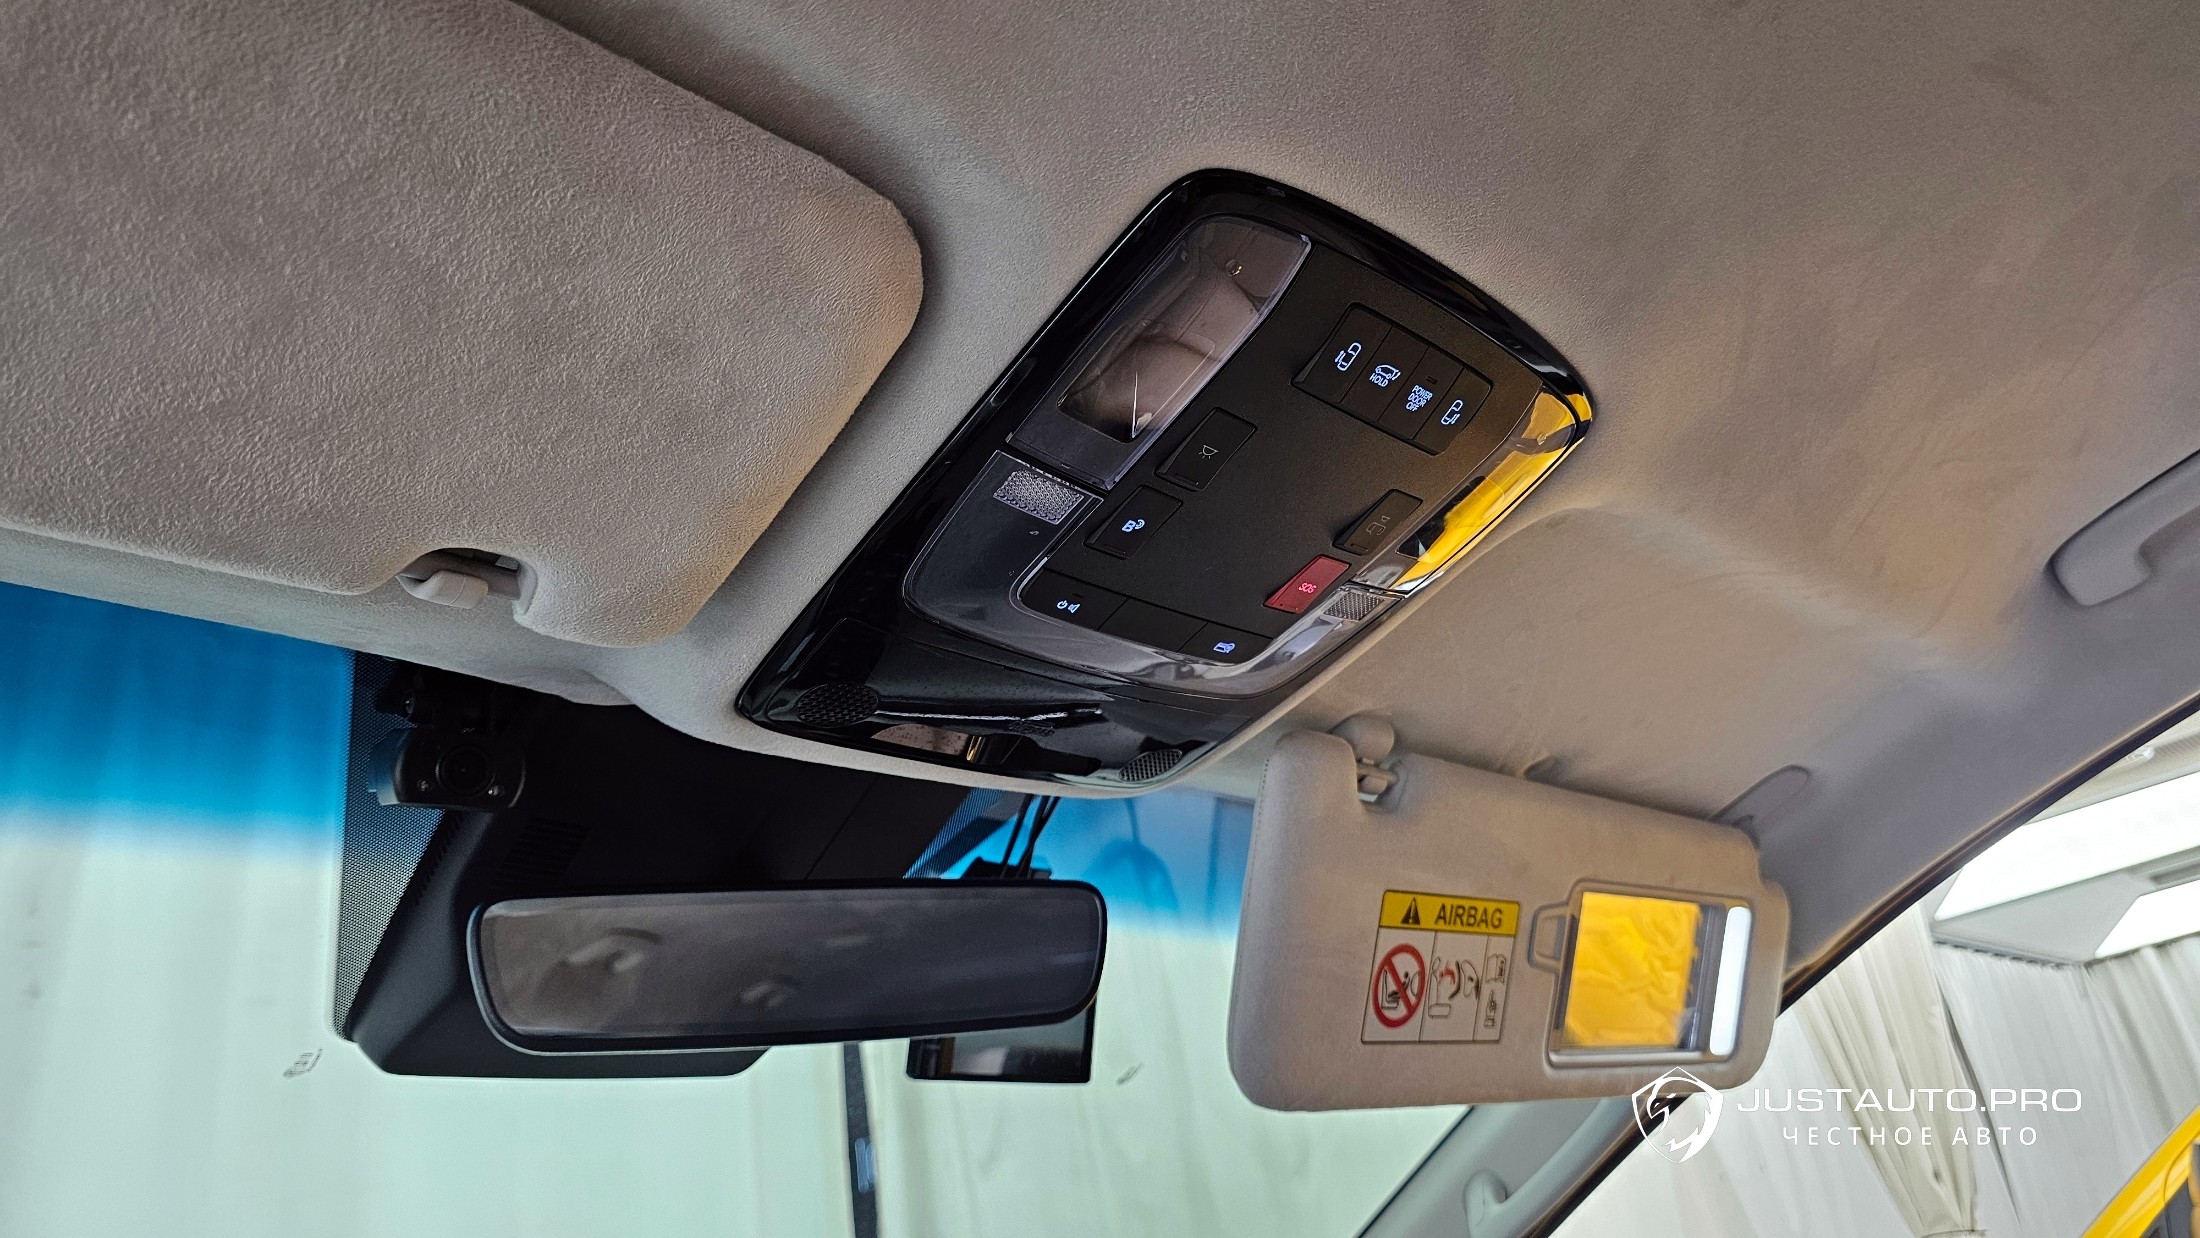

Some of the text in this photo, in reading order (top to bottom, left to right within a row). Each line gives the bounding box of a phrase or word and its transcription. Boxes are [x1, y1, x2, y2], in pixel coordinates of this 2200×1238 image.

[1369, 372, 1388, 387] HOLD
[1408, 393, 1427, 407] DOOR
[1411, 385, 1433, 401] POWER
[1406, 402, 1419, 412] OFF
[1298, 582, 1317, 594] SOS
[1434, 903, 1503, 929] AIRBAG
